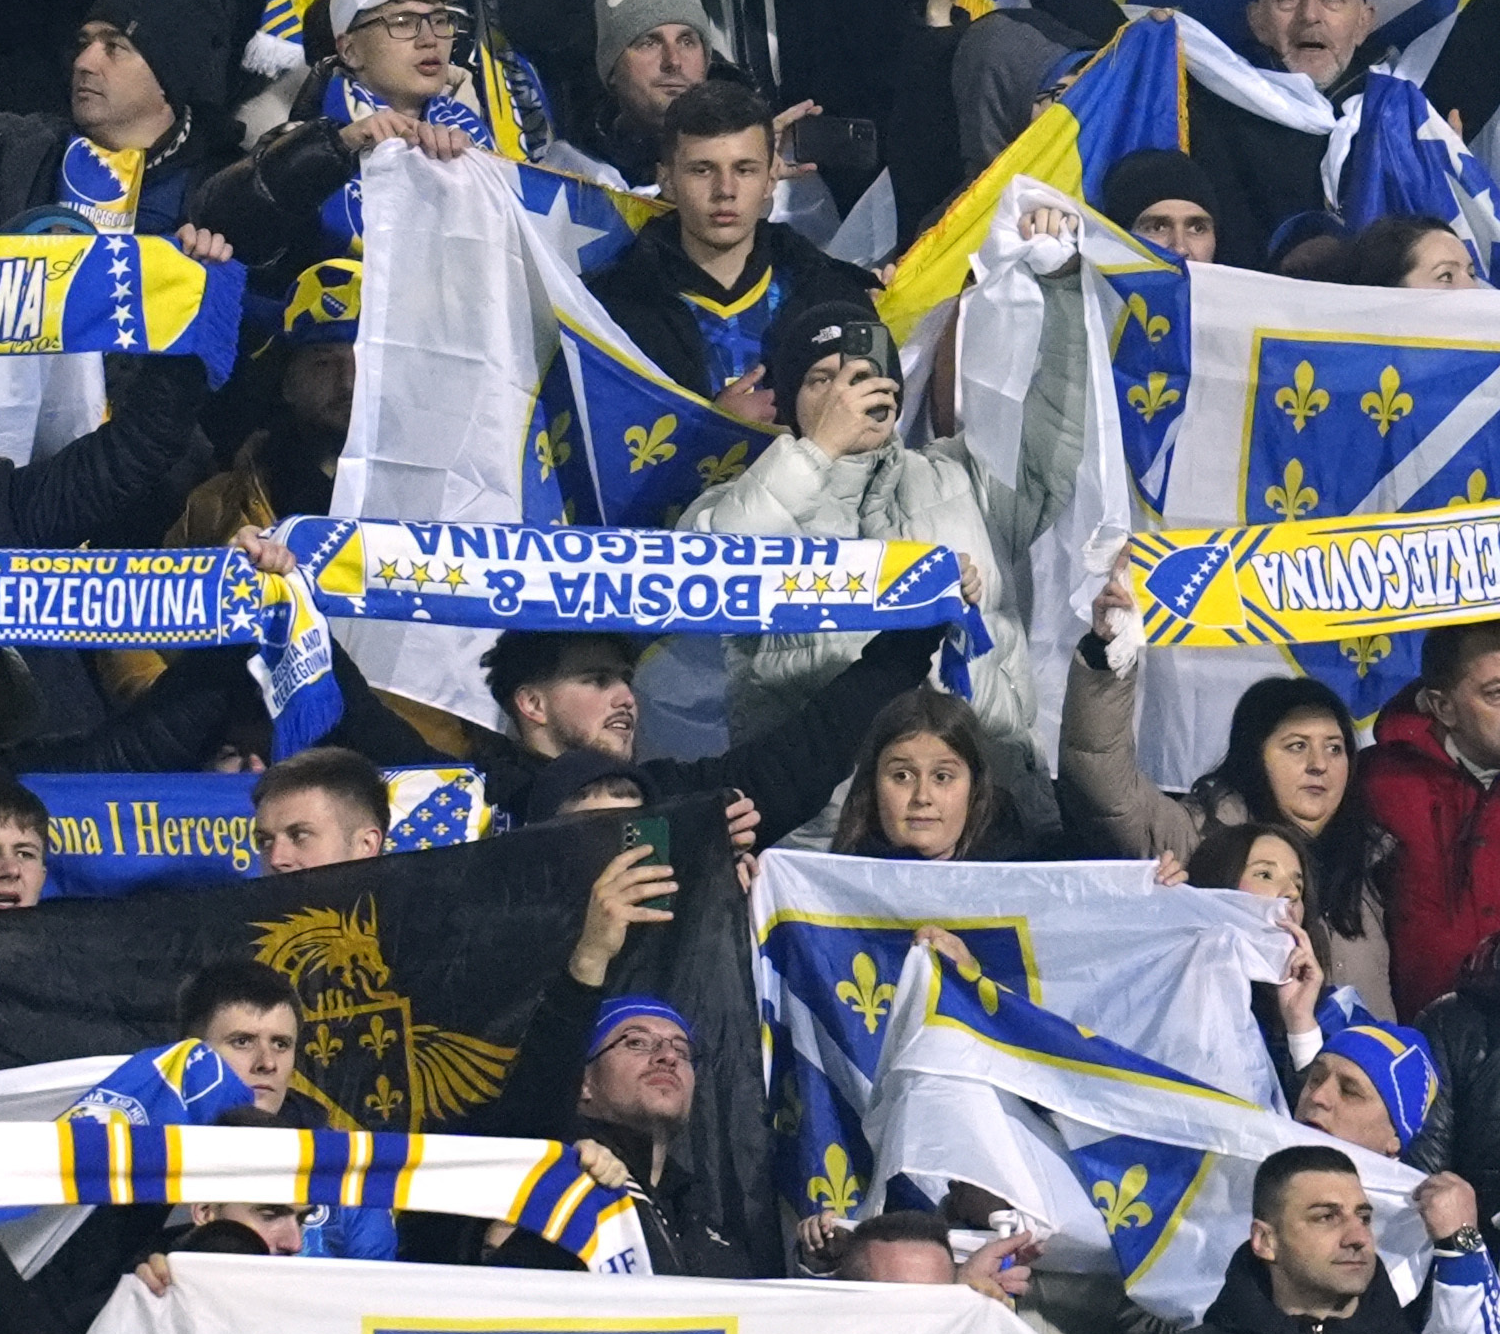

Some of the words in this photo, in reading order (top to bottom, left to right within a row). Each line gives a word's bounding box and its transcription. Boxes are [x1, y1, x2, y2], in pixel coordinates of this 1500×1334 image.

[7, 555, 116, 574] BOSNU
[123, 555, 216, 575] MOJU
[403, 522, 840, 566] HERCEGOVINA
[485, 568, 525, 616] &
[548, 571, 763, 619] BOSNA
[300, 628, 323, 652] AND
[46, 814, 104, 856] sna
[107, 805, 122, 857] I
[126, 800, 260, 865] Hercego
